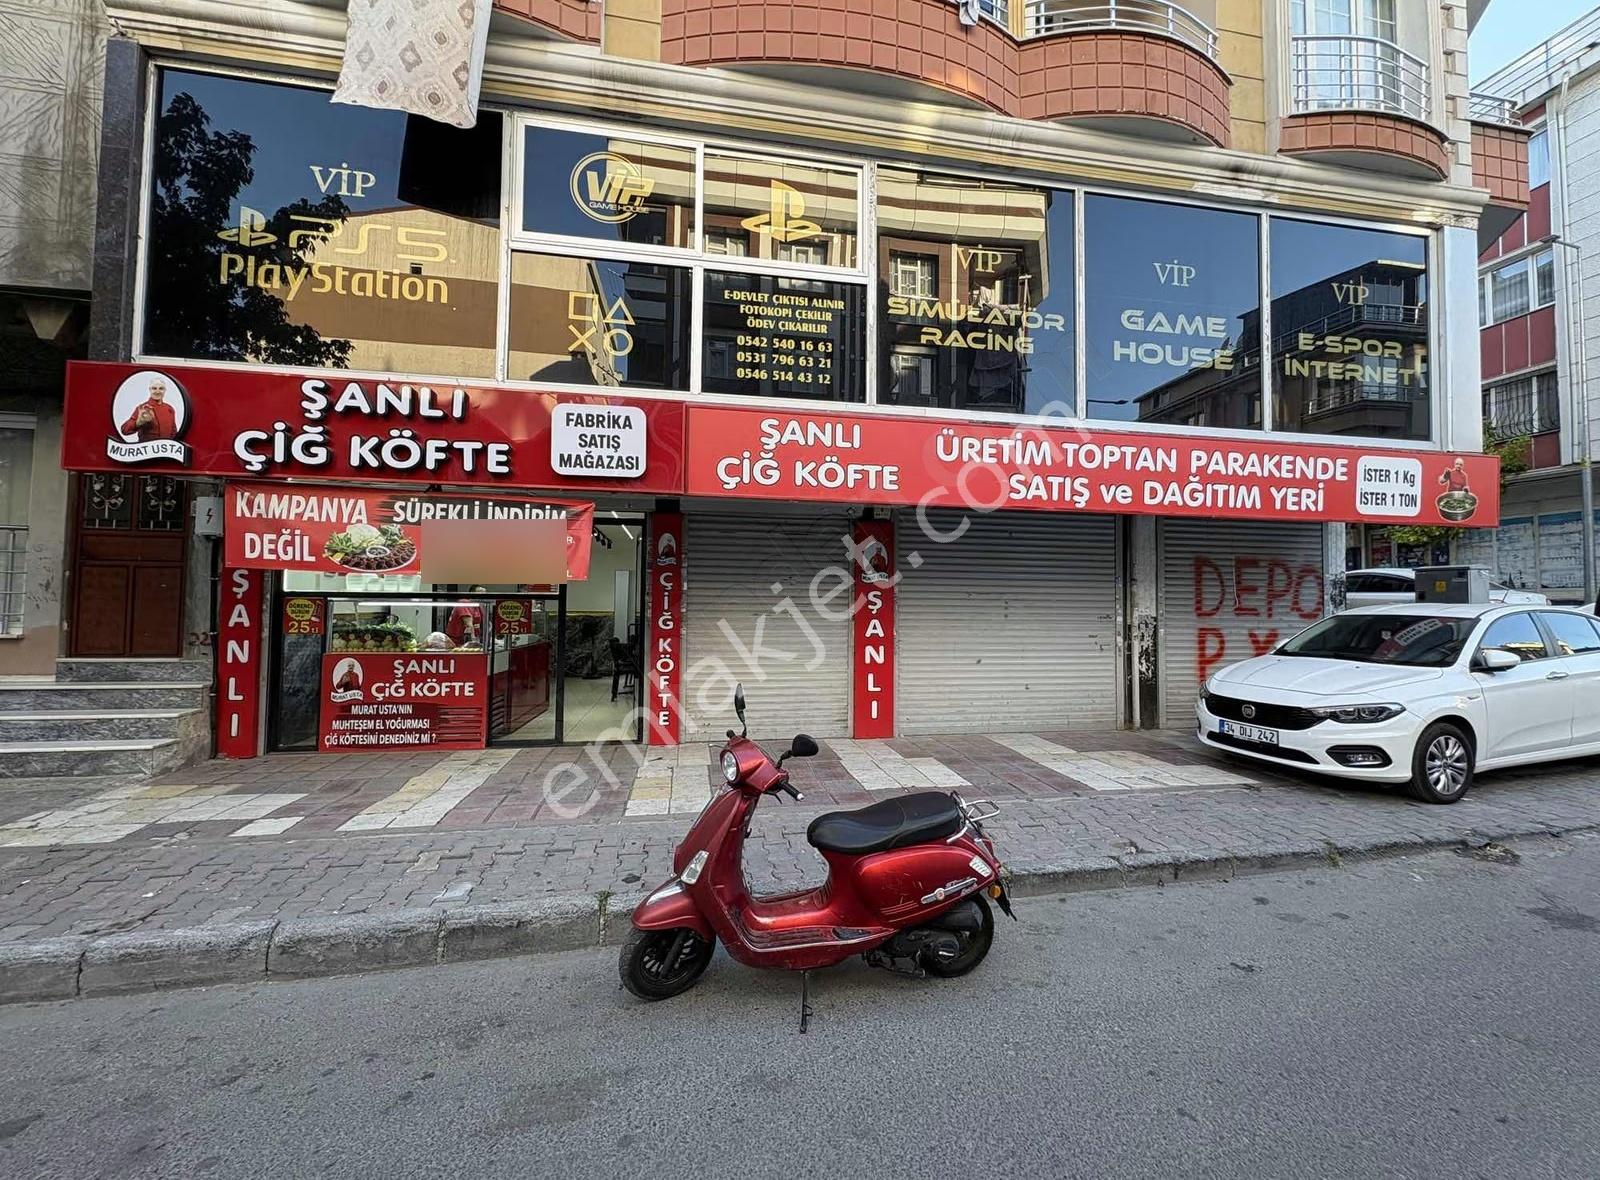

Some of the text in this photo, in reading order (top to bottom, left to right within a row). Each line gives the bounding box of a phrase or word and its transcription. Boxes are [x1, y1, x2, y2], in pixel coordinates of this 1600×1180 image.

[310, 162, 376, 198] VİP
[589, 201, 617, 211] GAME
[220, 253, 448, 304] PlayStation
[1153, 259, 1196, 287] VİP
[724, 290, 845, 310] E-DEVLET ÇIKTISI ALINIR
[747, 316, 828, 334] ÖDEV ÇIKARILIR
[1120, 309, 1227, 338] GAME
[736, 335, 833, 353] 0542 540 16 63
[920, 328, 1034, 354] RACİNG
[1298, 333, 1403, 359] E-SPOR
[736, 351, 832, 369] 0531 796 63 21
[1113, 340, 1235, 371] HOUSE
[736, 368, 831, 385] 0546 514 43 12
[1284, 353, 1415, 386] İNTERNET
[301, 379, 465, 419] ŞANLI
[565, 411, 633, 430] FABRİKA
[578, 433, 621, 452] SATIŞ
[759, 418, 862, 450] ŞANLI
[109, 443, 183, 457] MURAT USTA
[234, 421, 510, 474] ÇİĞ KÖFTE
[558, 450, 640, 471] MAĞAZASI
[936, 428, 1348, 481] ÜRETİM TOPTAN PARAKENDE
[716, 450, 899, 490] ÇİĞ KÖFTE
[1363, 465, 1416, 487] İSTER 1 Kg
[1009, 473, 1324, 512] SATIŞ ve DAĞITIM YERİ
[1359, 488, 1418, 508] İSTER 1 TON
[235, 491, 368, 525] KAMPANYA
[244, 528, 316, 562] DEĞİL
[1193, 555, 1324, 619] DEPO
[657, 572, 674, 630] ÇİĞ
[288, 621, 310, 633] 25
[500, 622, 519, 633] 25
[226, 569, 250, 737] ŞANLI
[864, 590, 885, 719] ŞANLI
[393, 659, 455, 677] ŞANLI
[411, 679, 475, 697] KÖFTE
[655, 638, 675, 726] KÖFTE
[351, 704, 413, 714] MURAT USTA'NIN
[332, 717, 430, 732] MUHTEŞEM EL YOĞURMASI
[1225, 722, 1235, 734] 34
[1257, 730, 1275, 743] 242
[324, 732, 338, 748] ÇİĞ
[339, 731, 378, 744] KÖFTESİNİ
[380, 731, 419, 744] DENEDİNİZ
[420, 731, 430, 743] Mİ
